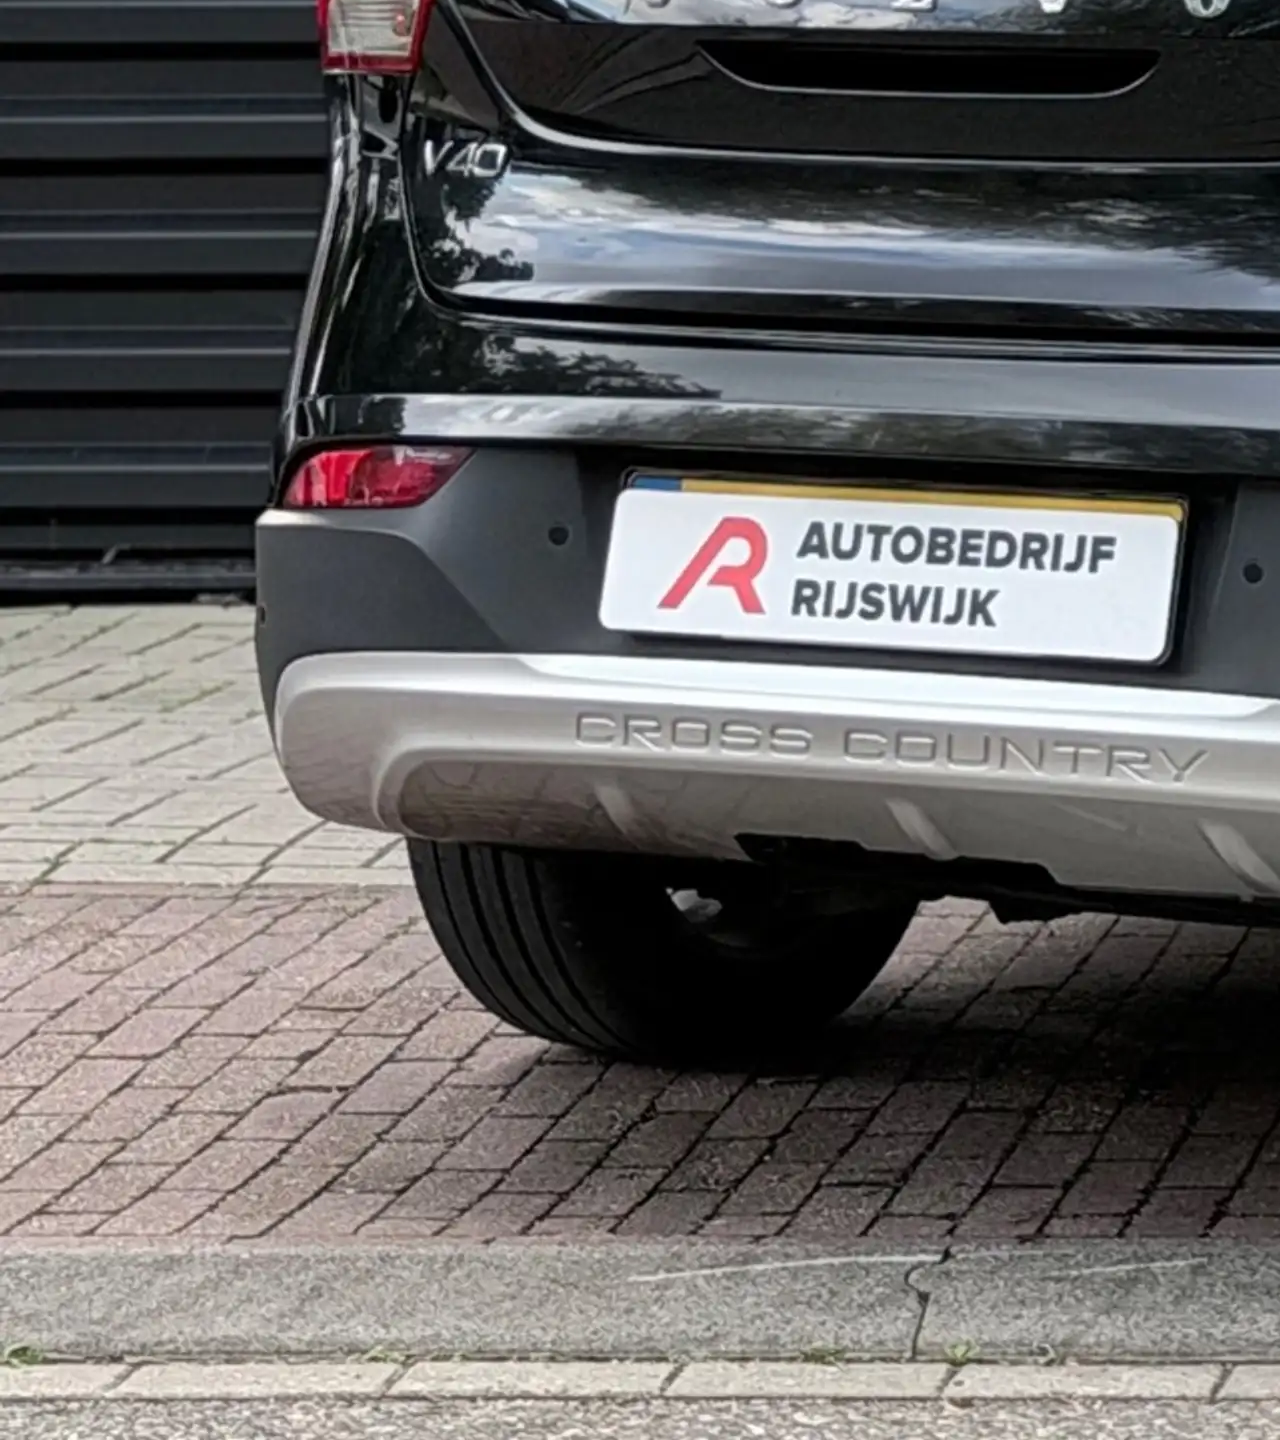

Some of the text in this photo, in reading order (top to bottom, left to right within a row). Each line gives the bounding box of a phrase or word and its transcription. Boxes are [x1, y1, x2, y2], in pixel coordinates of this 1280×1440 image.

[424, 140, 507, 177] V40
[796, 521, 1118, 574] AUTOBEDRIJF
[790, 578, 1000, 627] RIJSWIJK
[574, 711, 1209, 785] CROSS COUNTRY
